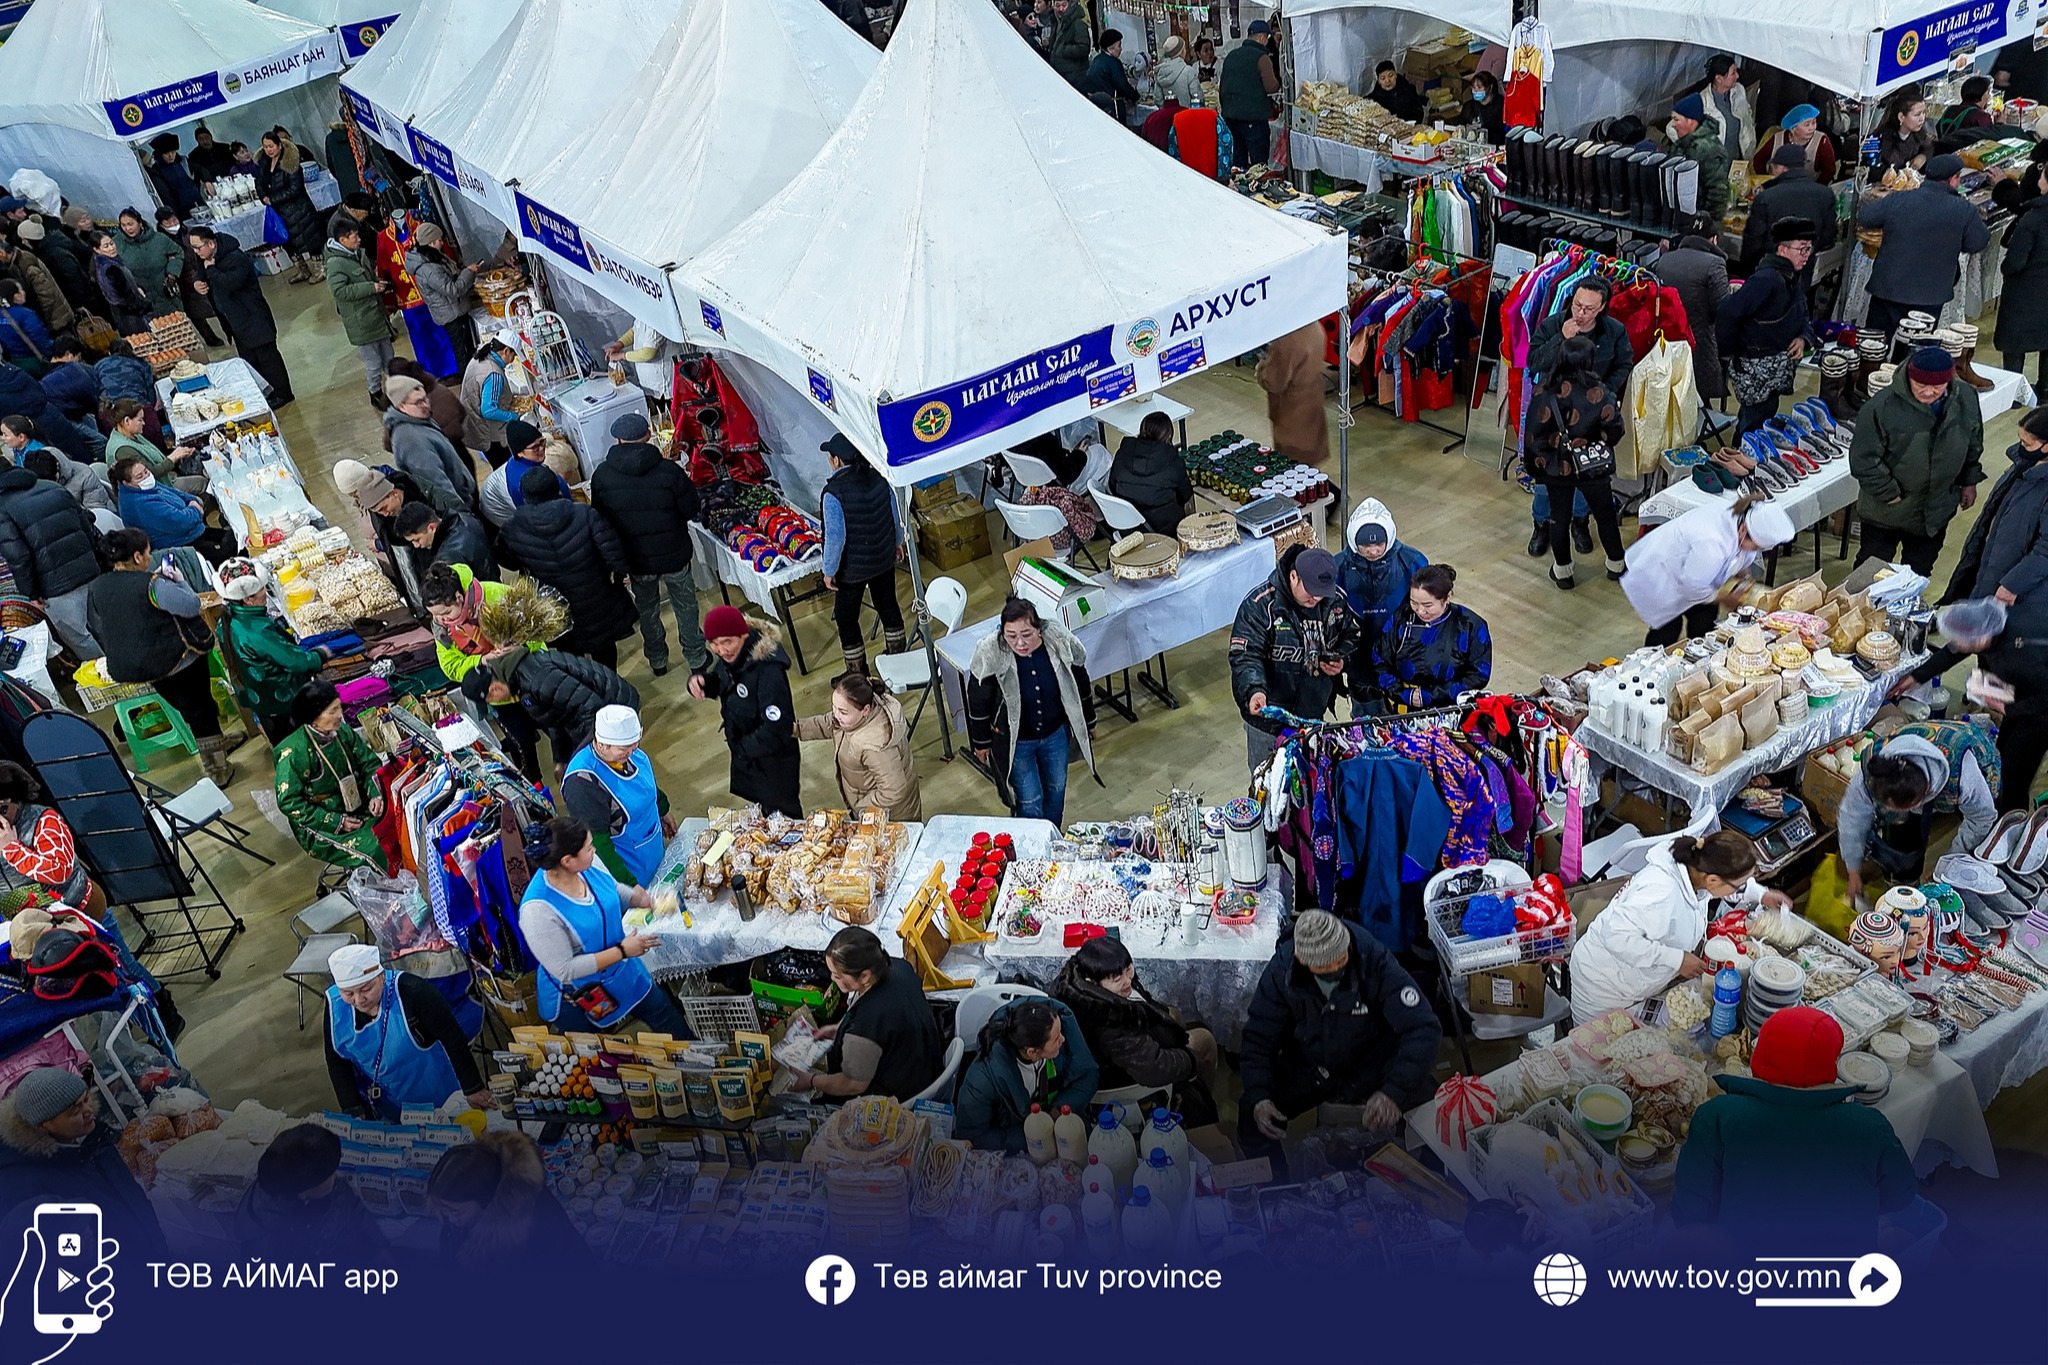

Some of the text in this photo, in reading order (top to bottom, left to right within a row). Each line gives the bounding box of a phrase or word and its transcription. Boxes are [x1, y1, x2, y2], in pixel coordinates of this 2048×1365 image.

[1925, 2, 1995, 40] ЦАГААН САР
[243, 46, 326, 86] БАЯНЦАГААН
[600, 253, 663, 302] БАТСҮМБЭР
[1169, 275, 1271, 338] АРХУСТ
[962, 343, 1082, 408] ЦАГААН САР
